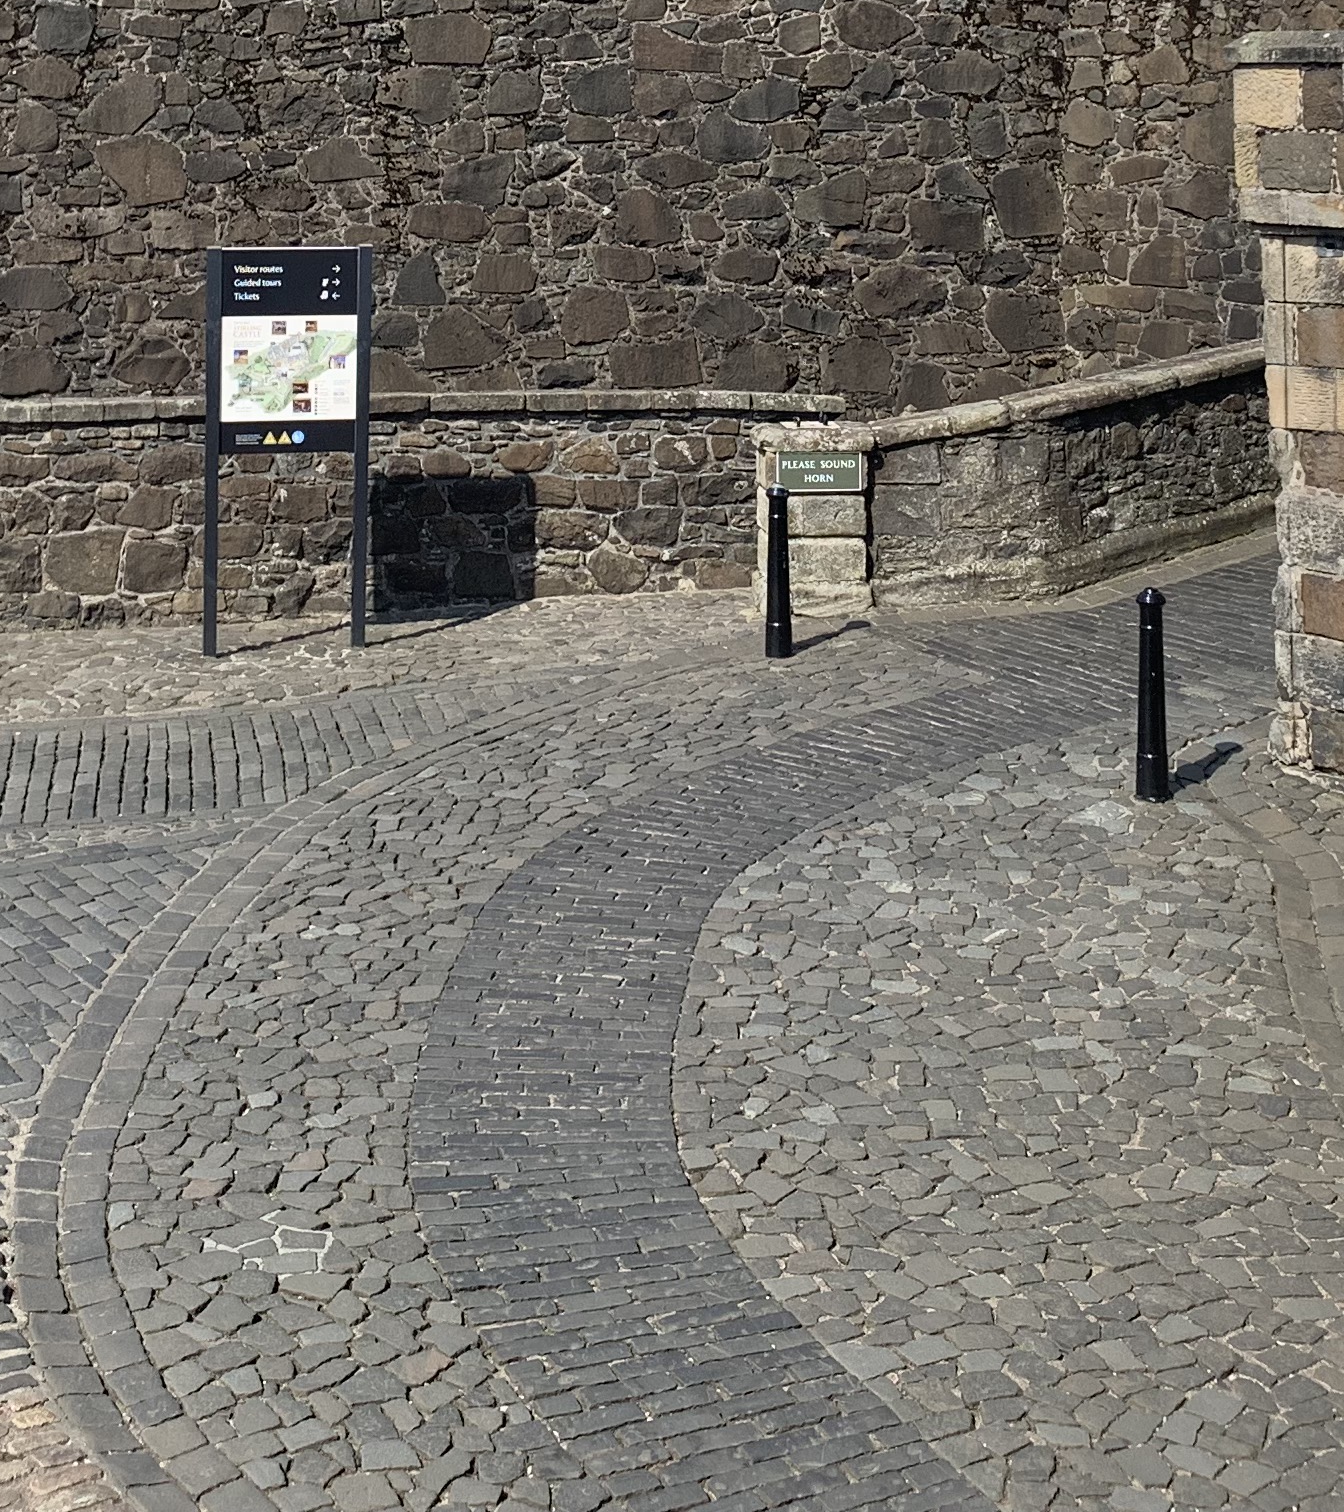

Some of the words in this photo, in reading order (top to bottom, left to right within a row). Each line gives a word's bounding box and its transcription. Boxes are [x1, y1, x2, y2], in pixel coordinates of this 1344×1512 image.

[234, 265, 258, 273] Visitor
[234, 278, 261, 287] Guided
[262, 279, 282, 287] tours
[233, 292, 260, 300] Tickets
[781, 460, 815, 469] PLEASE
[820, 459, 855, 468] SOUND
[804, 474, 834, 483] HORN
